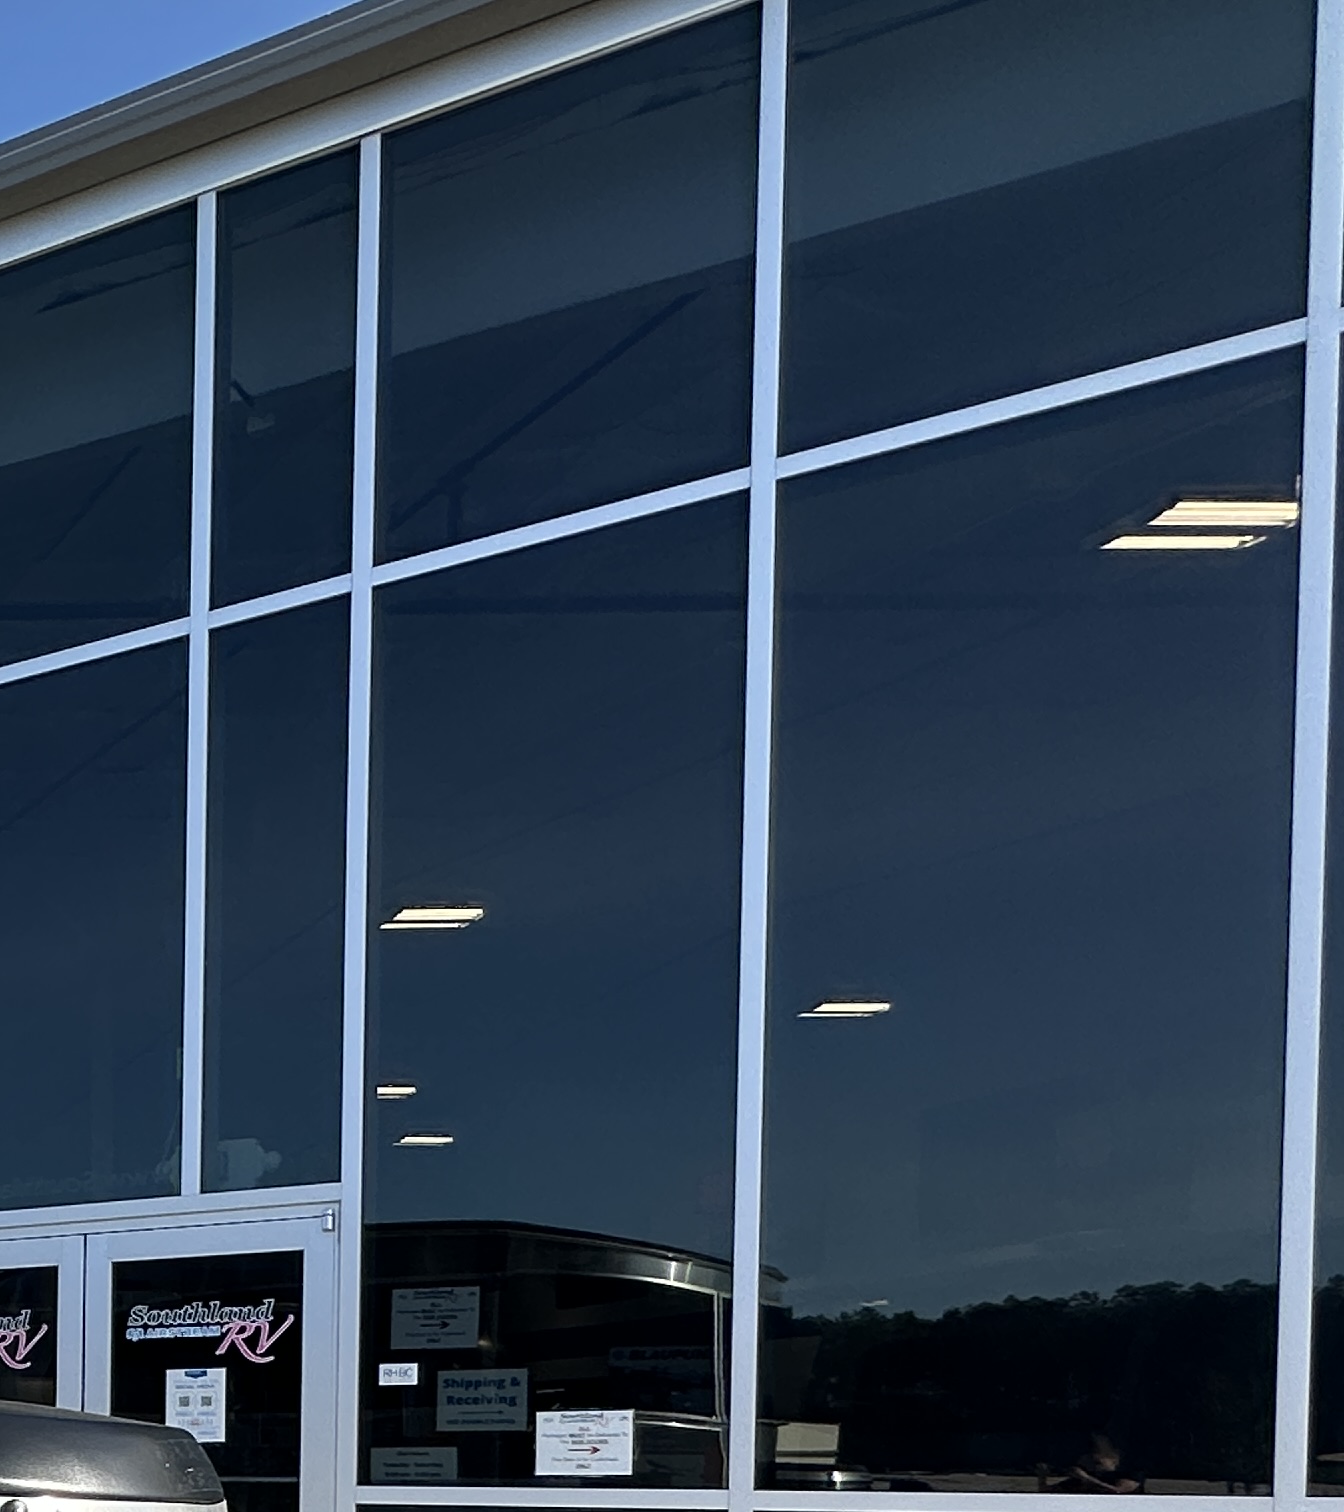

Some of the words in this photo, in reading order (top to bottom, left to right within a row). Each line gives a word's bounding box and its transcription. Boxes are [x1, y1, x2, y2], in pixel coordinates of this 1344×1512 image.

[127, 1298, 276, 1327] Southland
[215, 1314, 295, 1364] RV
[442, 1377, 506, 1390] Shipping
[510, 1377, 521, 1387] &
[446, 1393, 518, 1407] Receiving
